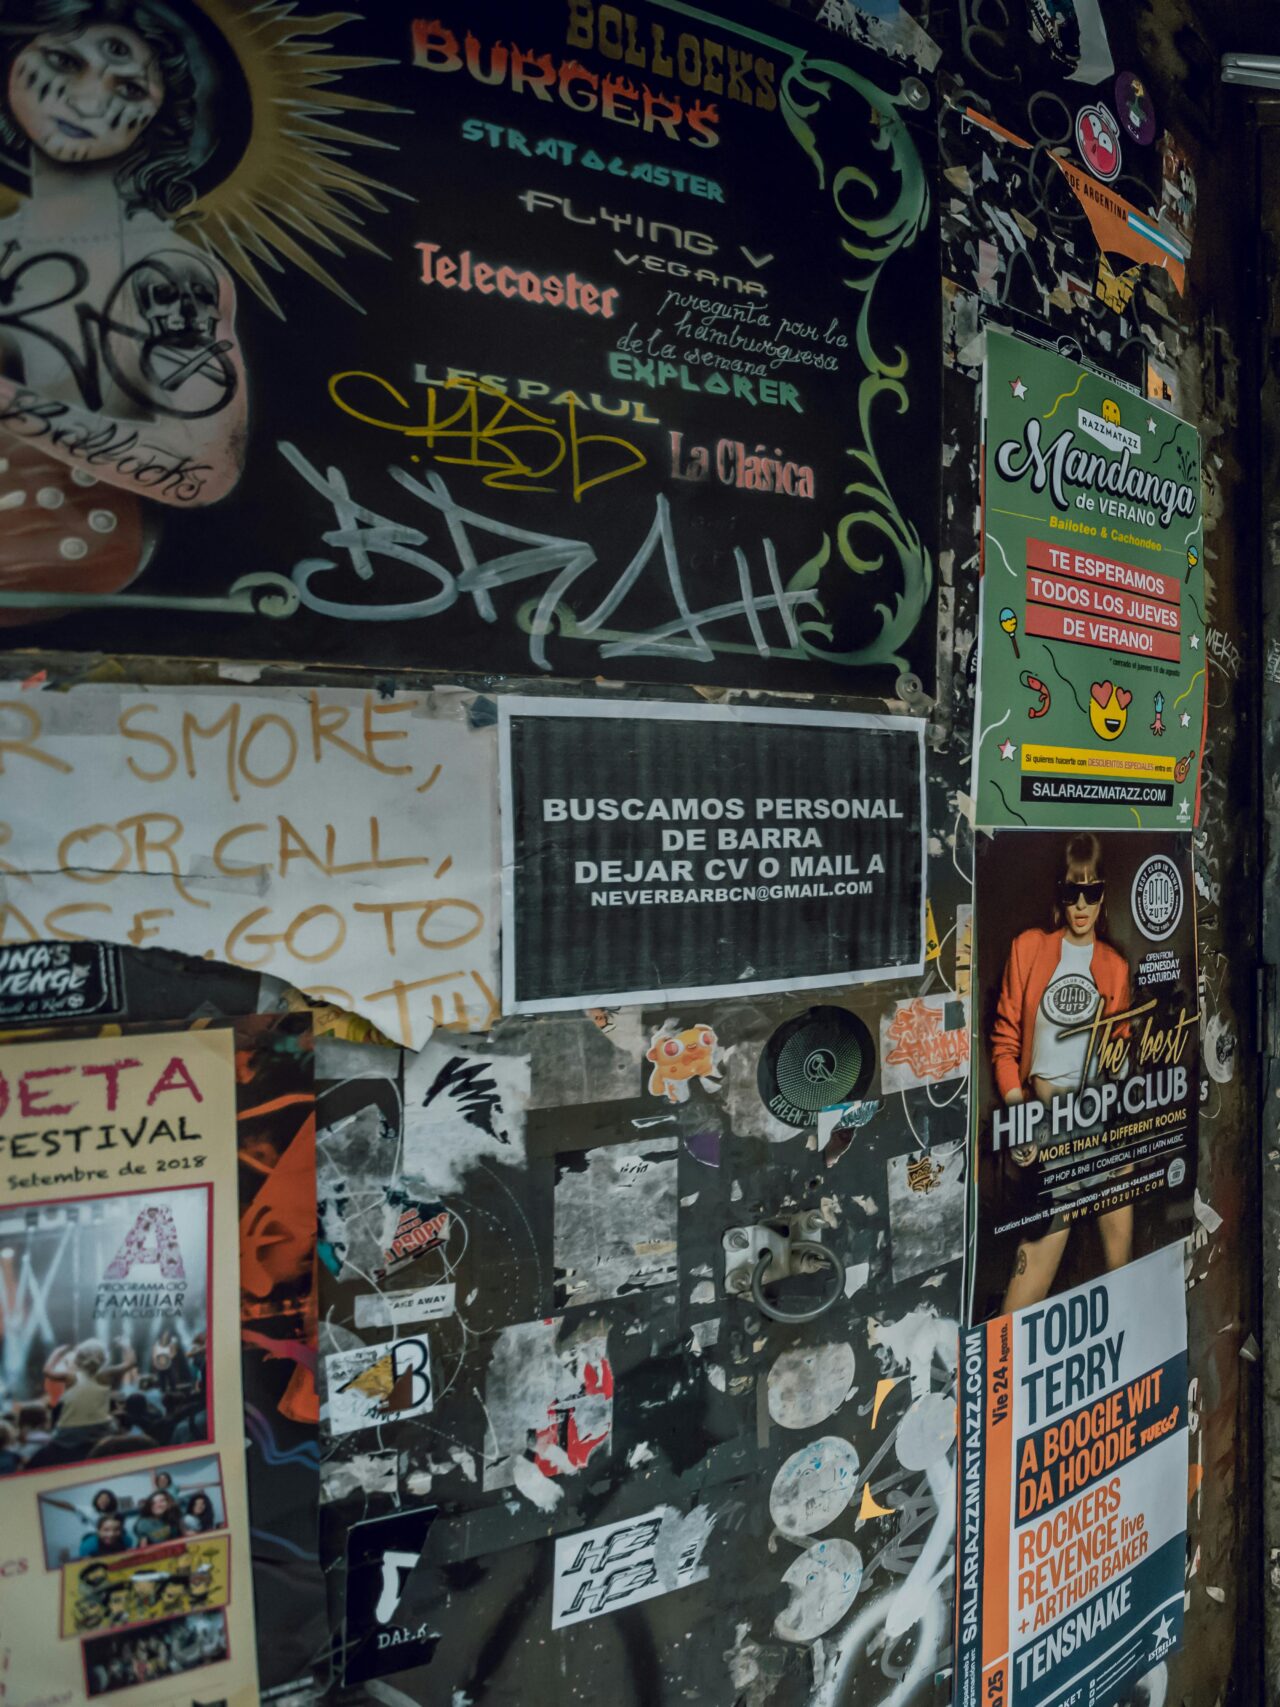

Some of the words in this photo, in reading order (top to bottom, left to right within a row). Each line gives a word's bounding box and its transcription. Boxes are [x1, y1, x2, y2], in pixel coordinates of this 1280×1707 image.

[410, 16, 721, 149] BURGERS
[518, 188, 718, 256] FLYING
[740, 243, 776, 270] V
[413, 240, 620, 319] Telecaster
[613, 247, 769, 298] VEGANA
[656, 288, 772, 328] pregunta
[774, 317, 820, 342] por
[823, 316, 849, 349] la
[674, 309, 840, 372] hamburguesa
[607, 349, 804, 414] EXPLORER
[1081, 416, 1139, 449] RAZZMATAZZ
[668, 430, 710, 483] La
[716, 436, 817, 500] Clásica
[994, 416, 1197, 530] Mandanga
[1048, 515, 1097, 537] Bailoteo
[1109, 528, 1163, 552] Cachondeo
[1075, 492, 1096, 512] de
[1099, 496, 1156, 527] VERANO
[1048, 548, 1071, 571] TE
[1074, 554, 1165, 595] ESPERAMOS
[1030, 577, 1091, 608] TODOS
[1093, 591, 1124, 615] LOS
[1126, 600, 1178, 628] JUEVES
[1063, 617, 1086, 639] DE
[1089, 622, 1154, 652] VERANO!
[542, 798, 746, 822] BUSCAMOS
[755, 798, 904, 820] PERSONAL
[1032, 782, 1167, 802] SALARAZZMATAZZ.COM
[212, 815, 453, 879] CALL,
[661, 828, 707, 852] DE
[716, 827, 823, 850] BARRA
[573, 860, 695, 884] DEJAR
[704, 858, 749, 881] CV
[757, 856, 780, 880] O
[789, 855, 861, 878] MAIL
[866, 853, 886, 875] A
[590, 880, 874, 907] NEVERBARBCN@GMAIL.COM
[1139, 958, 1180, 974] WEDNESDAY
[1147, 968, 1181, 984] SATURDAY
[992, 1100, 1045, 1153] HIP
[1052, 1082, 1119, 1136] HOP
[1122, 1066, 1188, 1115] CLUB
[1038, 1143, 1071, 1163] MORE
[1072, 1135, 1100, 1153] THAN
[1101, 1132, 1108, 1144] 4
[1109, 1118, 1154, 1142] DIFFERENT
[1154, 1108, 1187, 1128] ROOMS
[7, 1164, 110, 1191] Setembre
[117, 1160, 148, 1178] de
[155, 1154, 208, 1173] 2018
[94, 1292, 185, 1307] FAMILIAR
[1020, 1284, 1110, 1367] TODD
[999, 1323, 1009, 1364] Agosto.
[993, 1365, 1009, 1390] 24
[1020, 1329, 1126, 1427] TERRY
[992, 1392, 1009, 1427] Vie
[1019, 1437, 1039, 1480] A
[1043, 1390, 1124, 1469] BOOGIE
[1127, 1367, 1164, 1419] WIT
[1058, 1419, 1137, 1499] HOODIE
[962, 1330, 983, 1645] SALARAZZMATAZZ.COM
[1017, 1476, 1122, 1570] ROCKERS
[1017, 1513, 1119, 1612] REVENGE
[1120, 1512, 1145, 1542] live
[1017, 1618, 1030, 1634] +
[1032, 1567, 1099, 1633] ARTHUR
[1101, 1530, 1149, 1584] BAKER
[1016, 1576, 1133, 1692] TENSNAKE
